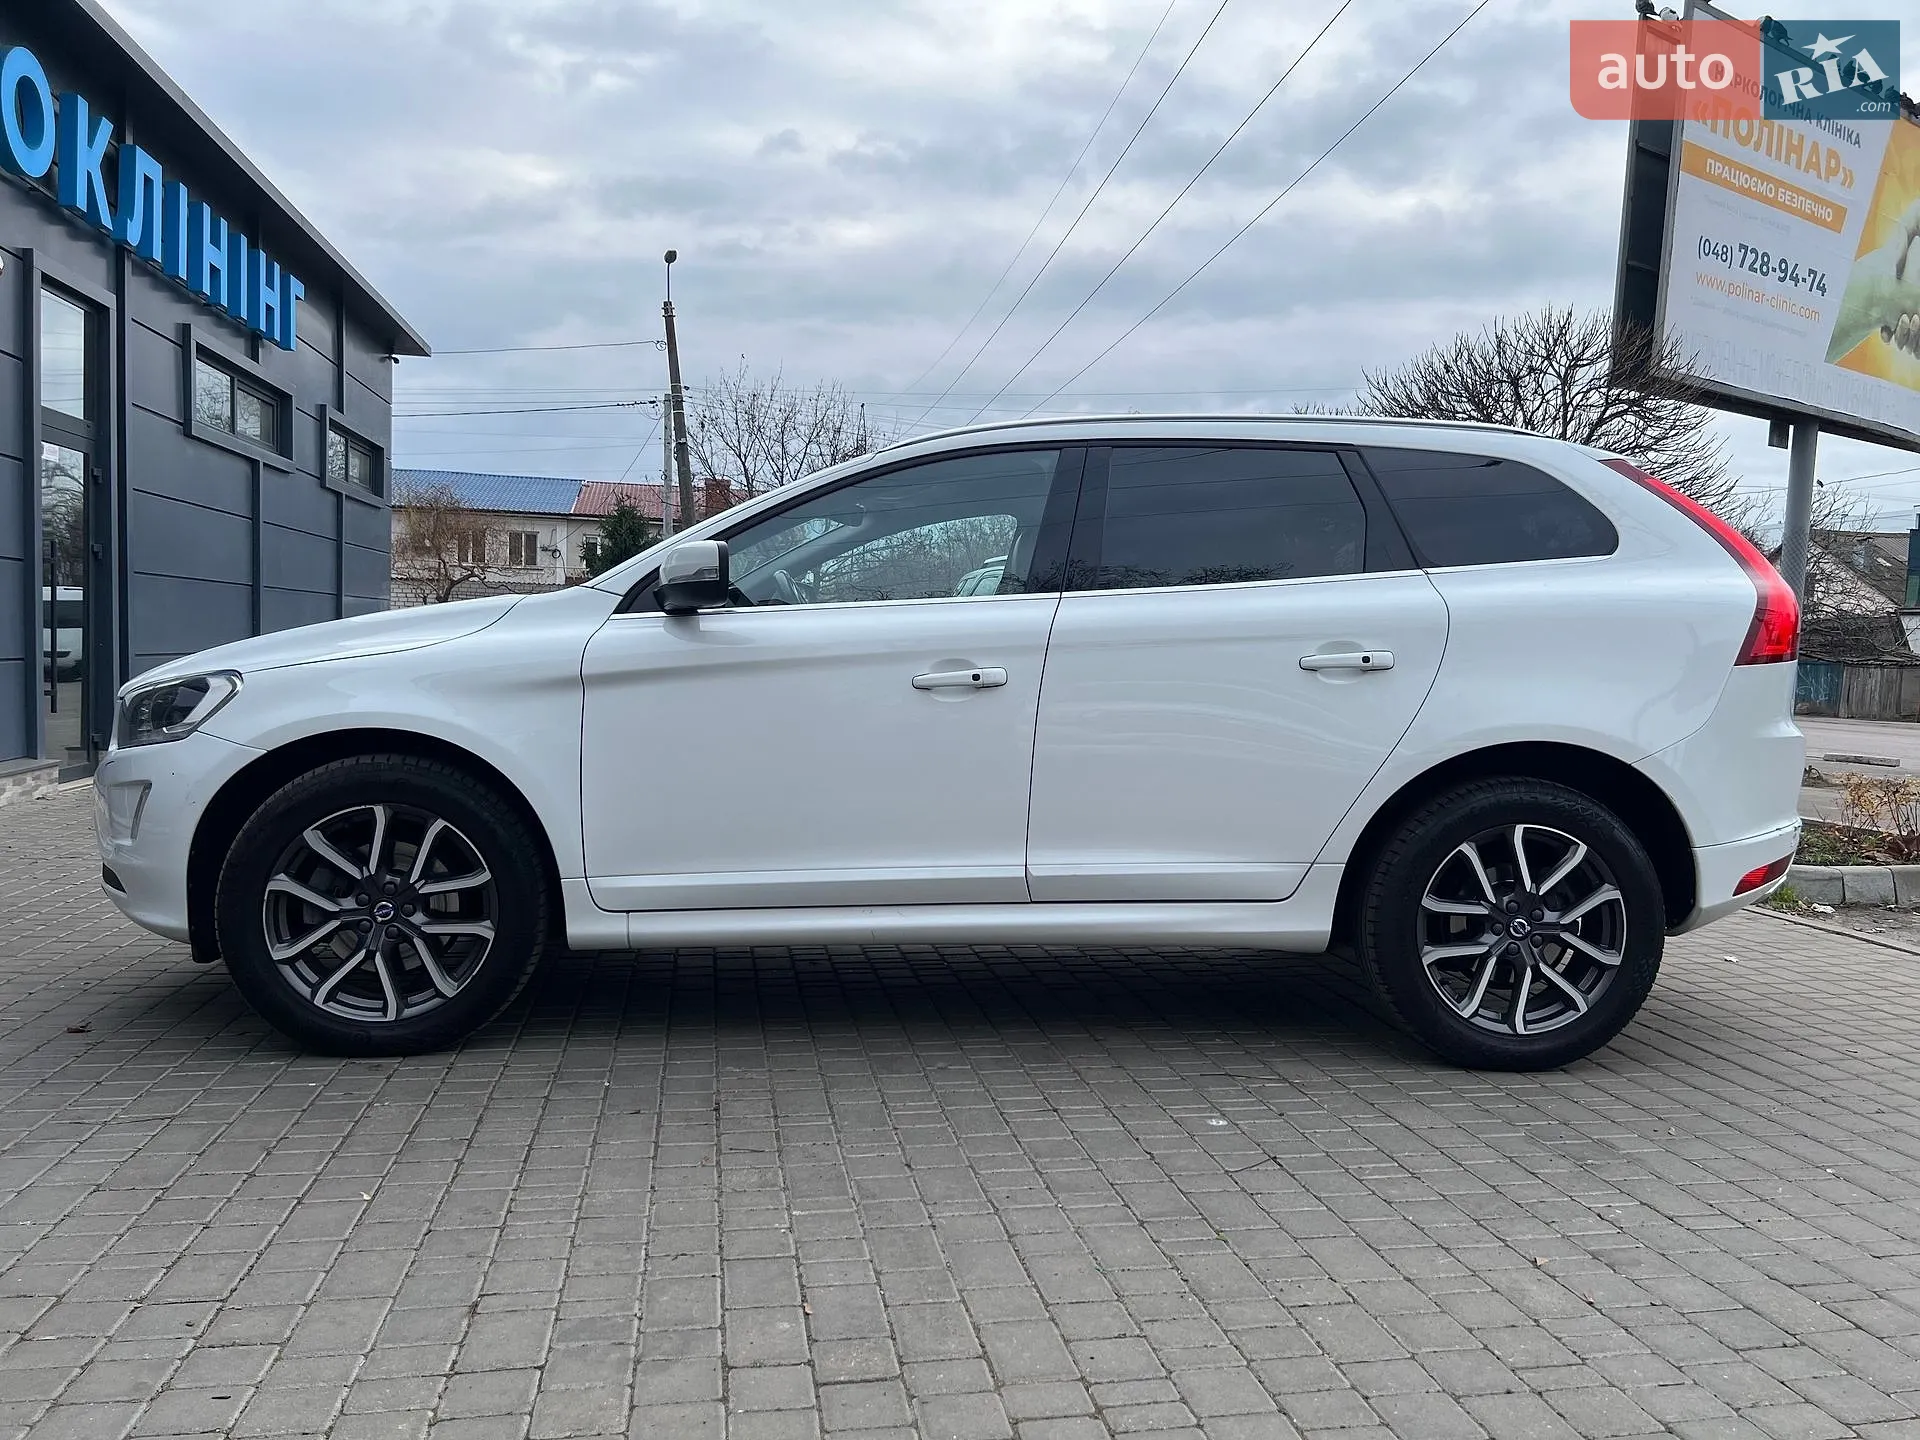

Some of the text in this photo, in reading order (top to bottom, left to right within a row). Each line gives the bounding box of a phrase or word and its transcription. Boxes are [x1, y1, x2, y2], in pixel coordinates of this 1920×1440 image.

[1692, 95, 1855, 190] «ПОЛІНАР»
[1714, 63, 1862, 149] НРКОЛОГЧНА КЛІНІКА
[0, 45, 305, 352] ОКЛІНІНГ
[1706, 158, 1775, 197] ПРАЦЮЄМО
[1777, 188, 1833, 222] БЕЗПЕЧНО
[1696, 271, 1820, 323] www.polinar-clinic.com
[1698, 235, 1827, 297] (048) 728-94-74
